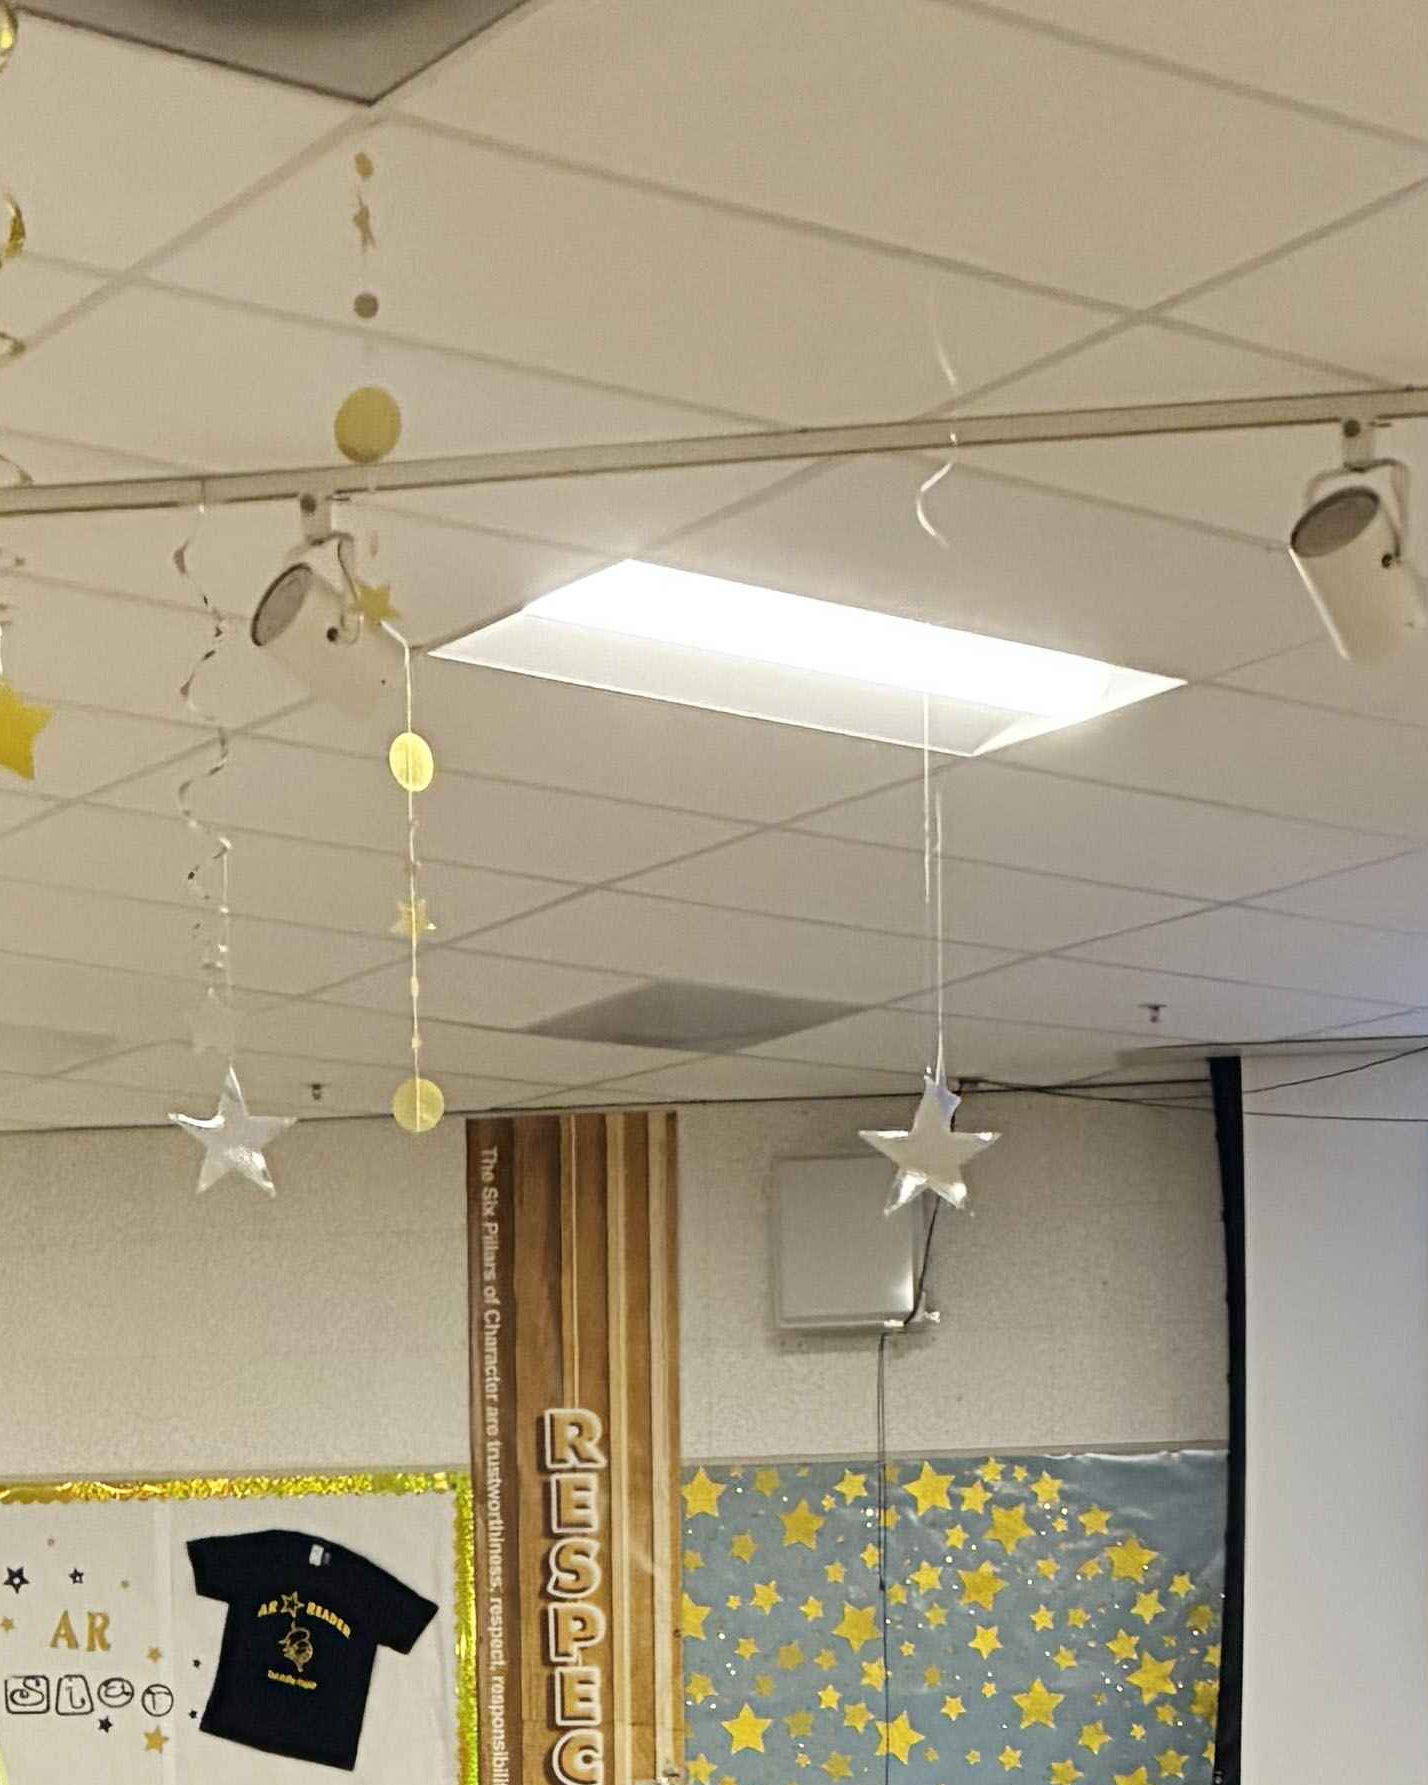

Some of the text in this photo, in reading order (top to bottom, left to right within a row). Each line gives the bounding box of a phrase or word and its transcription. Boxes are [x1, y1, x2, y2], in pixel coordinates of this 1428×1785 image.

[481, 1146, 498, 1183] The
[482, 1187, 499, 1216] Six
[483, 1222, 499, 1281] Pillars
[483, 1286, 501, 1305] of
[484, 1309, 501, 1402] Character
[486, 1406, 500, 1436] are
[50, 1610, 112, 1653] AR
[257, 1600, 351, 1639] AR READER
